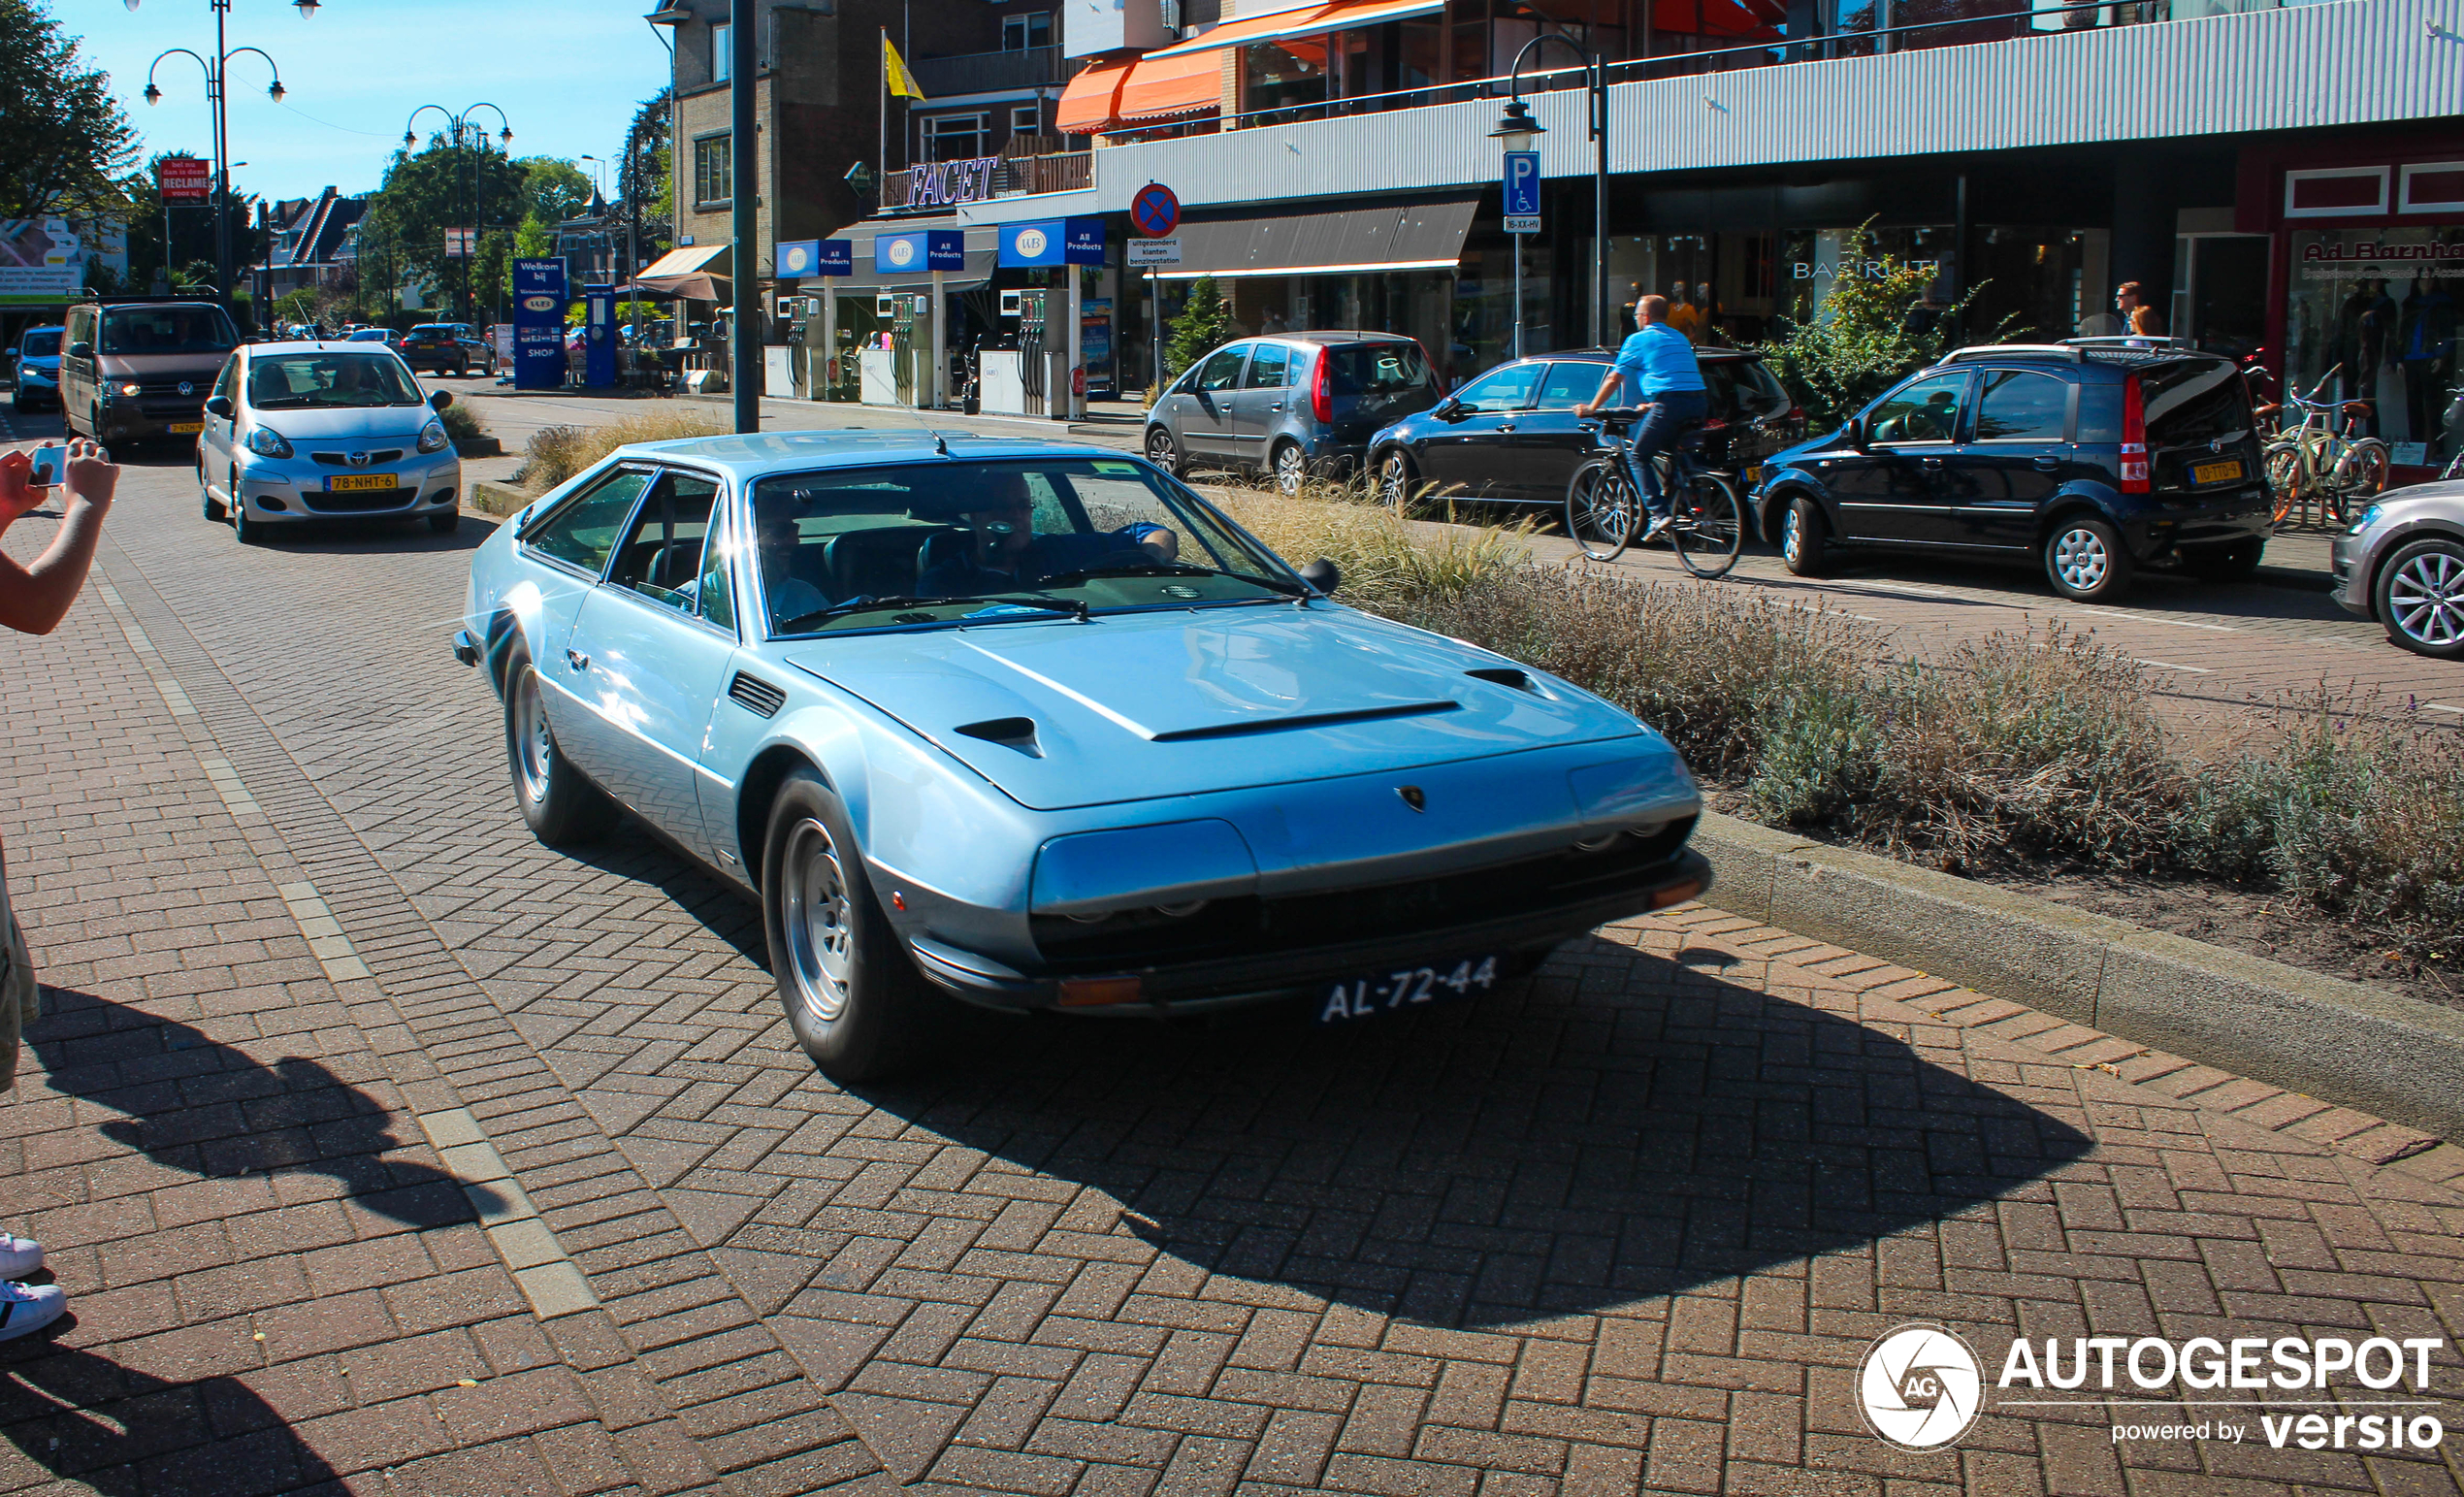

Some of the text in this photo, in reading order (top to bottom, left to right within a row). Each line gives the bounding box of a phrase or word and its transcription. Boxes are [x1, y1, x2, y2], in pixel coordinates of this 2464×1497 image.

[1514, 158, 1533, 189] P
[163, 178, 208, 188] RECLAME
[906, 156, 997, 206] FACET
[1508, 219, 1540, 229] 16-XX-HV
[1021, 238, 1040, 249] WB
[893, 247, 909, 257] WB
[2303, 242, 2344, 263] Ad
[535, 272, 546, 282] bij
[2199, 464, 2237, 480] 10-TTD-9
[334, 475, 392, 488] 78-NHT-6
[1321, 956, 1497, 1023] AL-72-44
